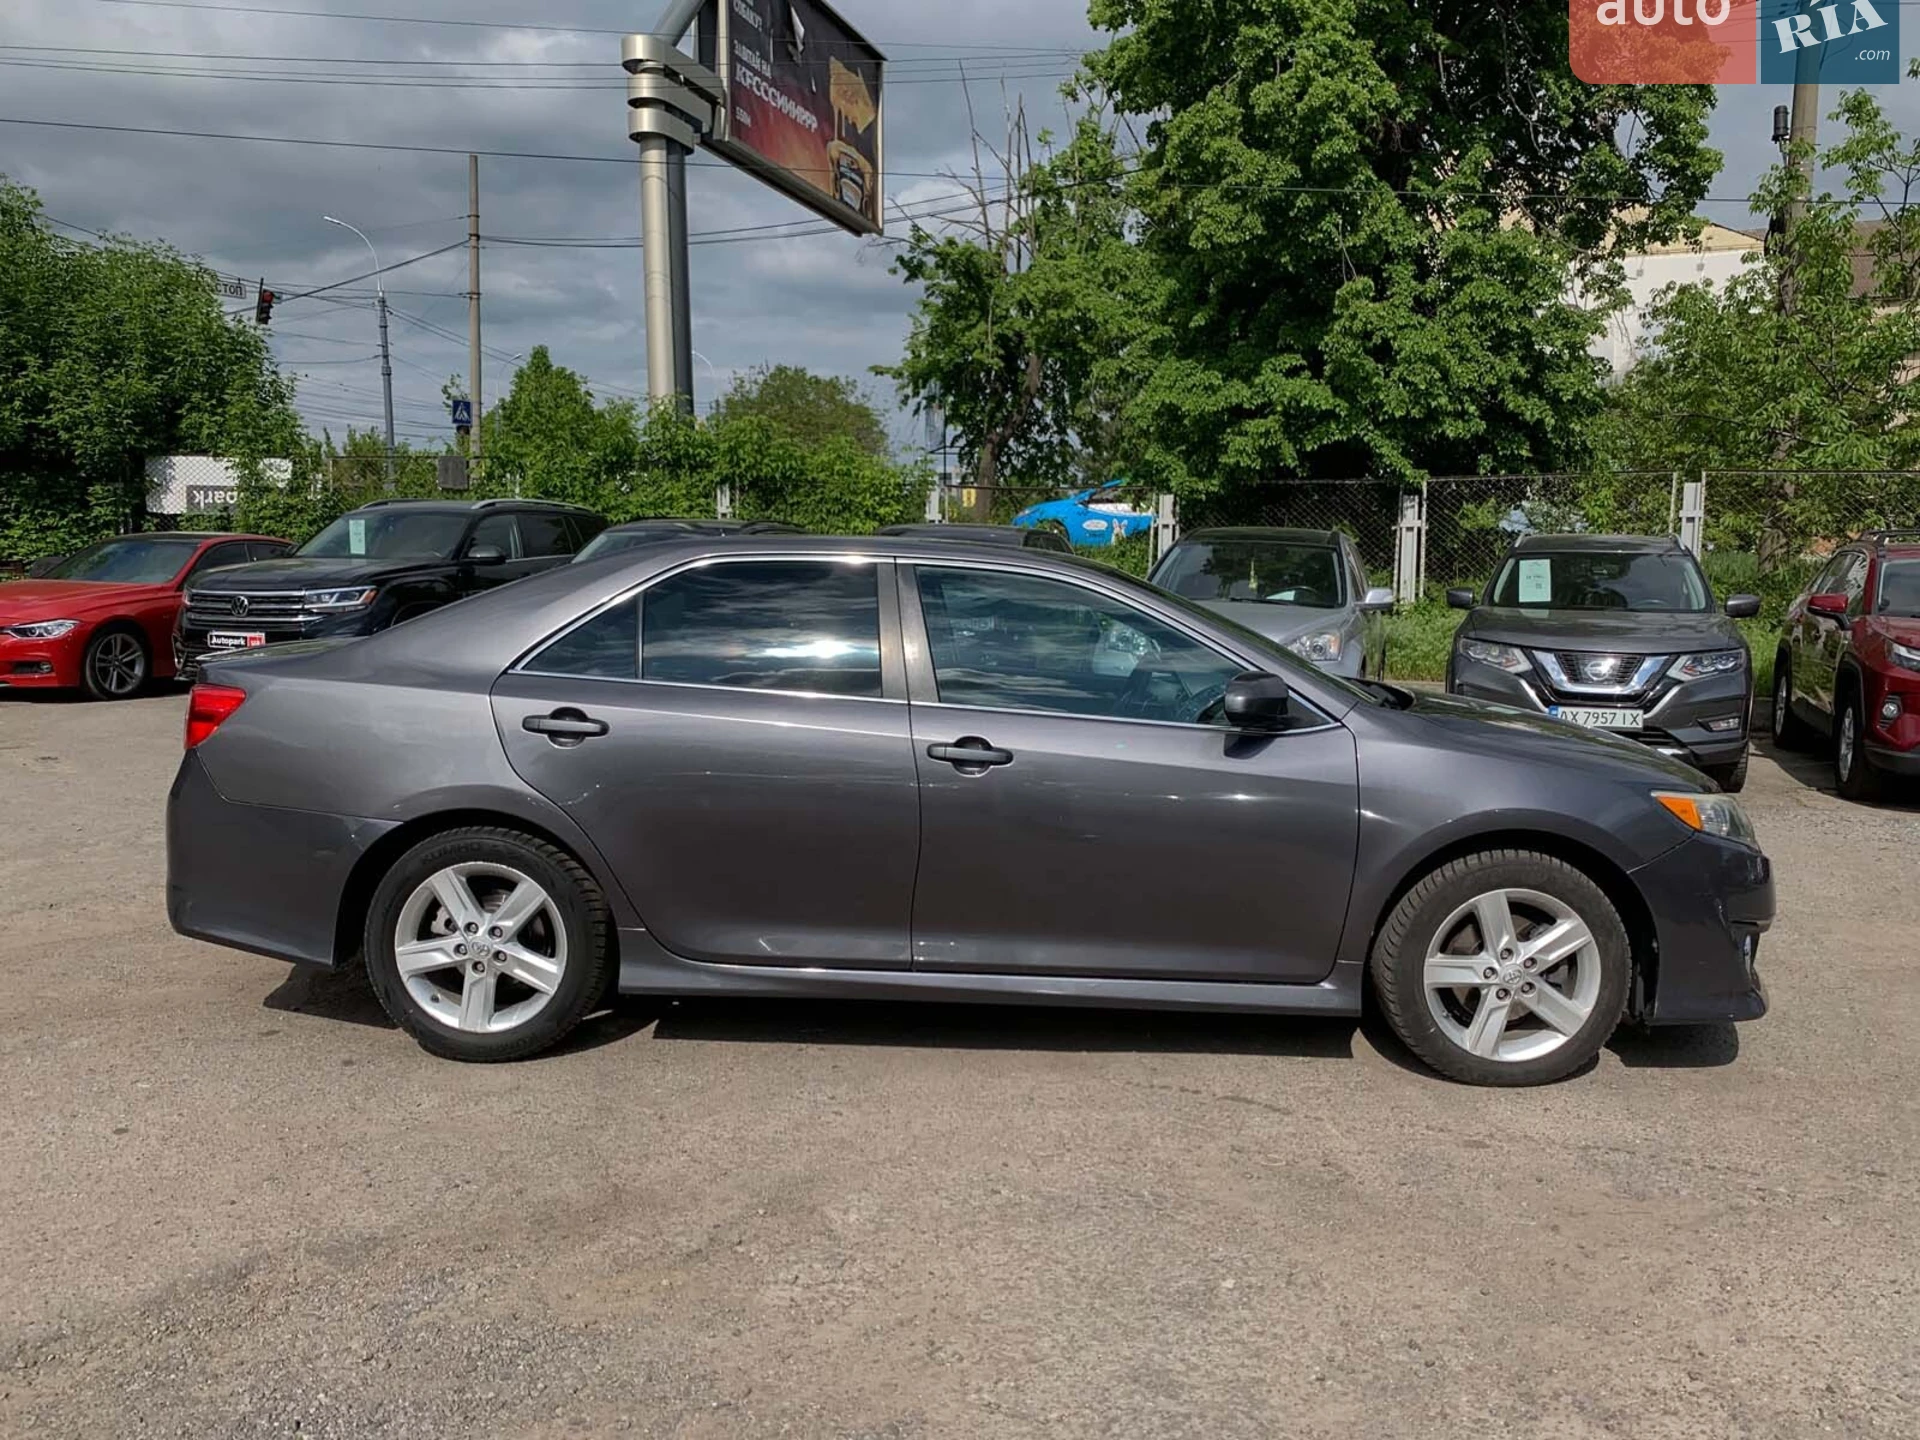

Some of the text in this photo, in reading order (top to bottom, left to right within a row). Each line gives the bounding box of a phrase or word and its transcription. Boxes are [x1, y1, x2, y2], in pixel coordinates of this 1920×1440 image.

[211, 635, 246, 648] Autopark
[1561, 711, 1579, 723] AX
[1583, 711, 1617, 725] 7957
[1622, 713, 1640, 726] IX
